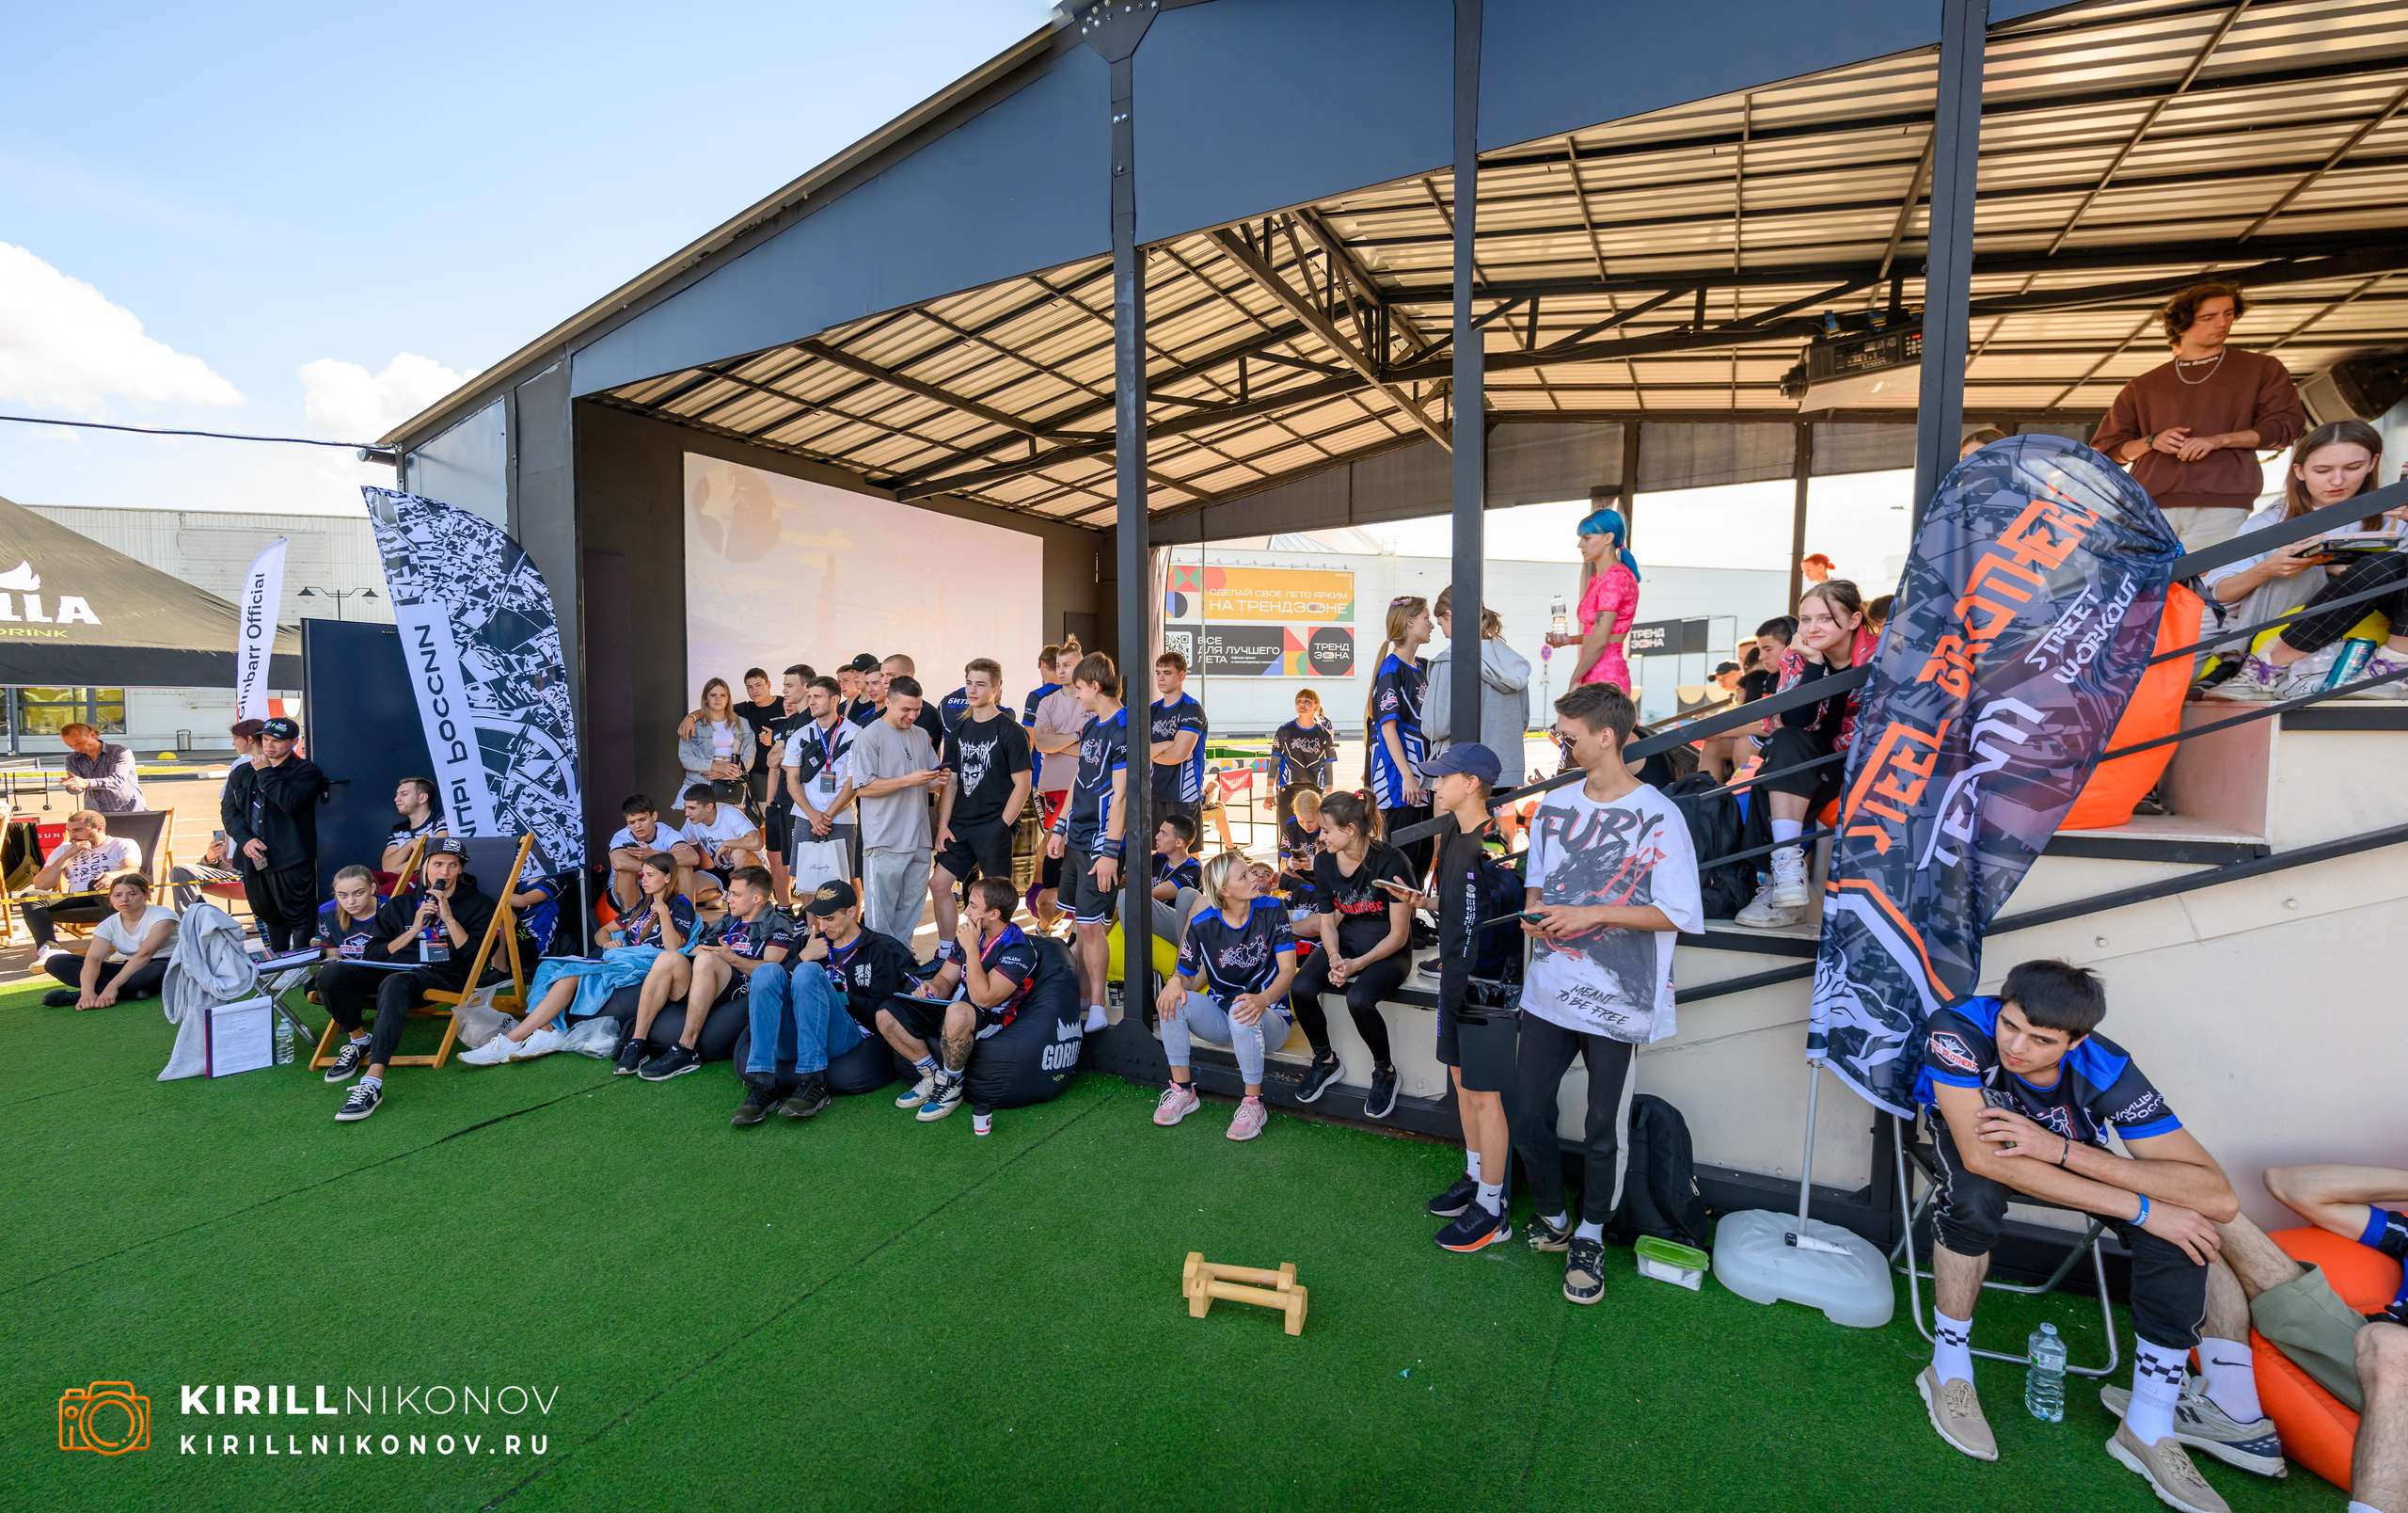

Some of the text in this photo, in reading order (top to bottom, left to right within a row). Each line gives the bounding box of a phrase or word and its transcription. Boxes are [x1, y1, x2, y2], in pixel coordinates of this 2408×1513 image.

[1209, 588, 1348, 600] СДЕЛАЙ СВОЕ ЛЕТО ЯРКИМ
[1209, 599, 1234, 612] НА
[2024, 583, 2100, 671] STREET
[2053, 572, 2137, 684] WORKOUT
[1631, 628, 1666, 640] ТРЕНД
[238, 572, 265, 720] Gimbarr Official
[1197, 636, 1223, 645] ВСЕ
[1630, 638, 1665, 649] ЗОНА
[1197, 645, 1280, 656] ДЛЯ ЛУЧШЕГО
[1313, 643, 1350, 652] ТРЕНД
[1313, 651, 1350, 660] ЗОНА
[1534, 804, 1665, 853] FURY
[1569, 983, 1619, 1005] MEANT
[1556, 989, 1631, 1025] TO BE FREE
